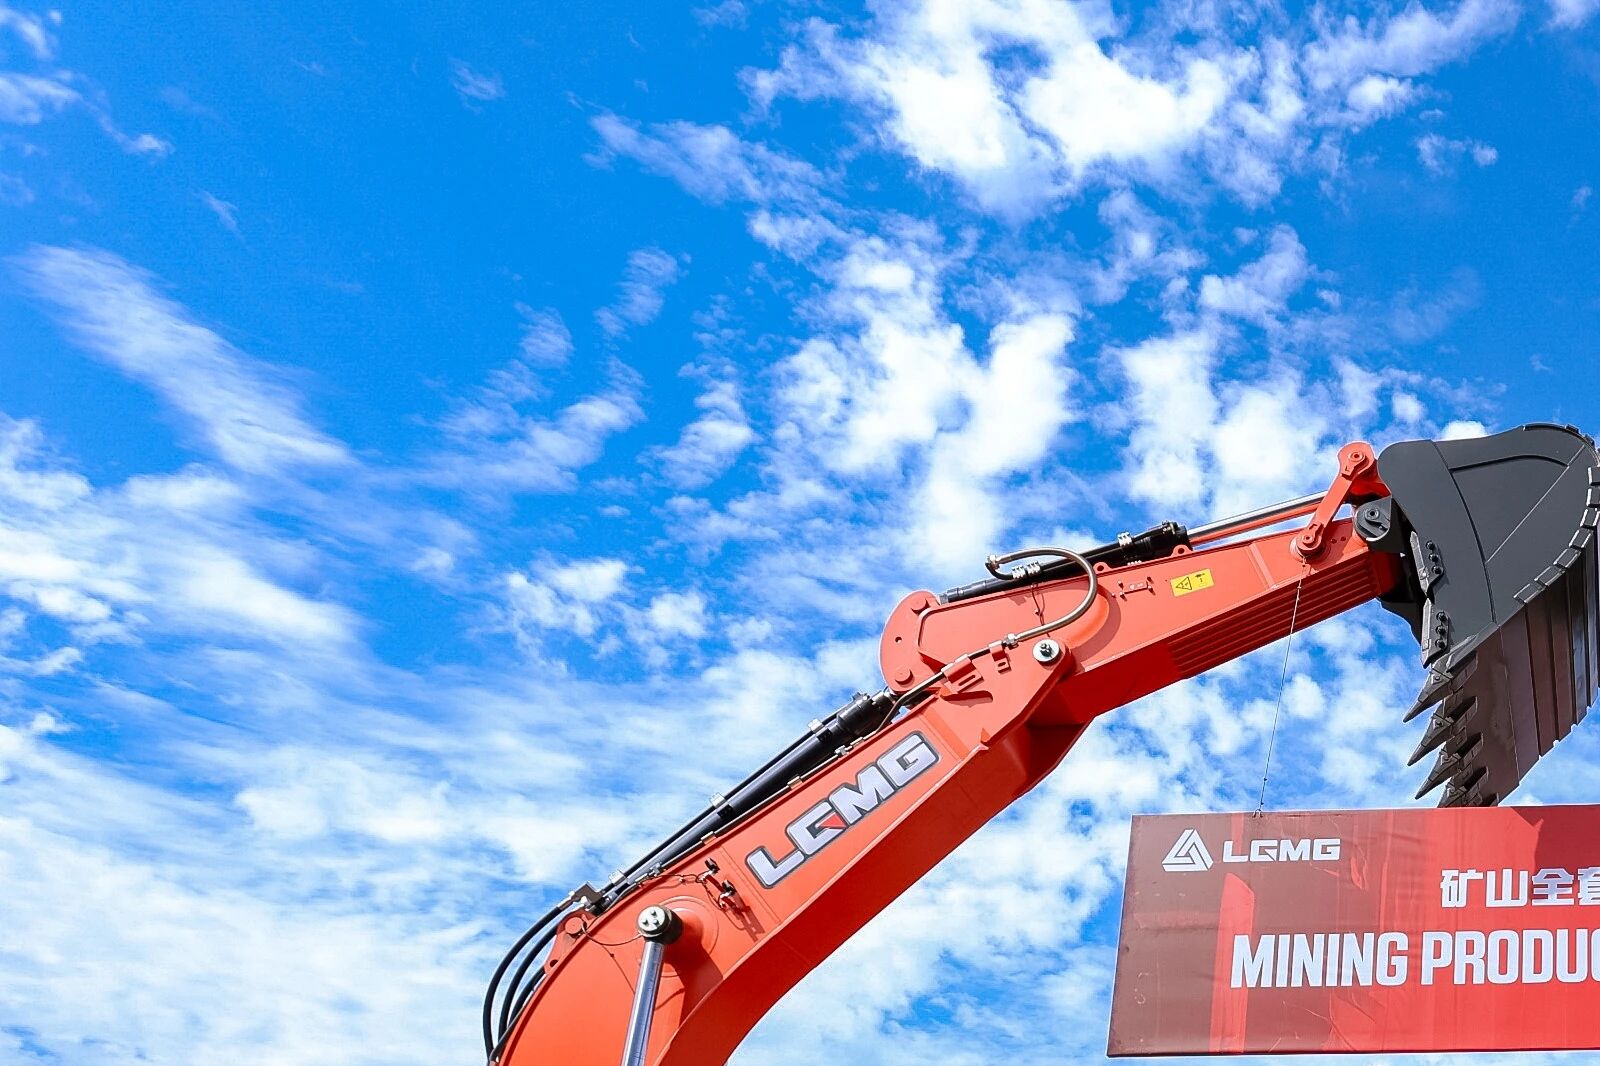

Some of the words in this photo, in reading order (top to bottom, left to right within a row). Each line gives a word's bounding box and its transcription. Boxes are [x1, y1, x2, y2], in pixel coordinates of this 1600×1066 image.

[745, 730, 940, 889] LGMG
[1223, 836, 1341, 865] LGMG
[1230, 931, 1409, 989] MINING
